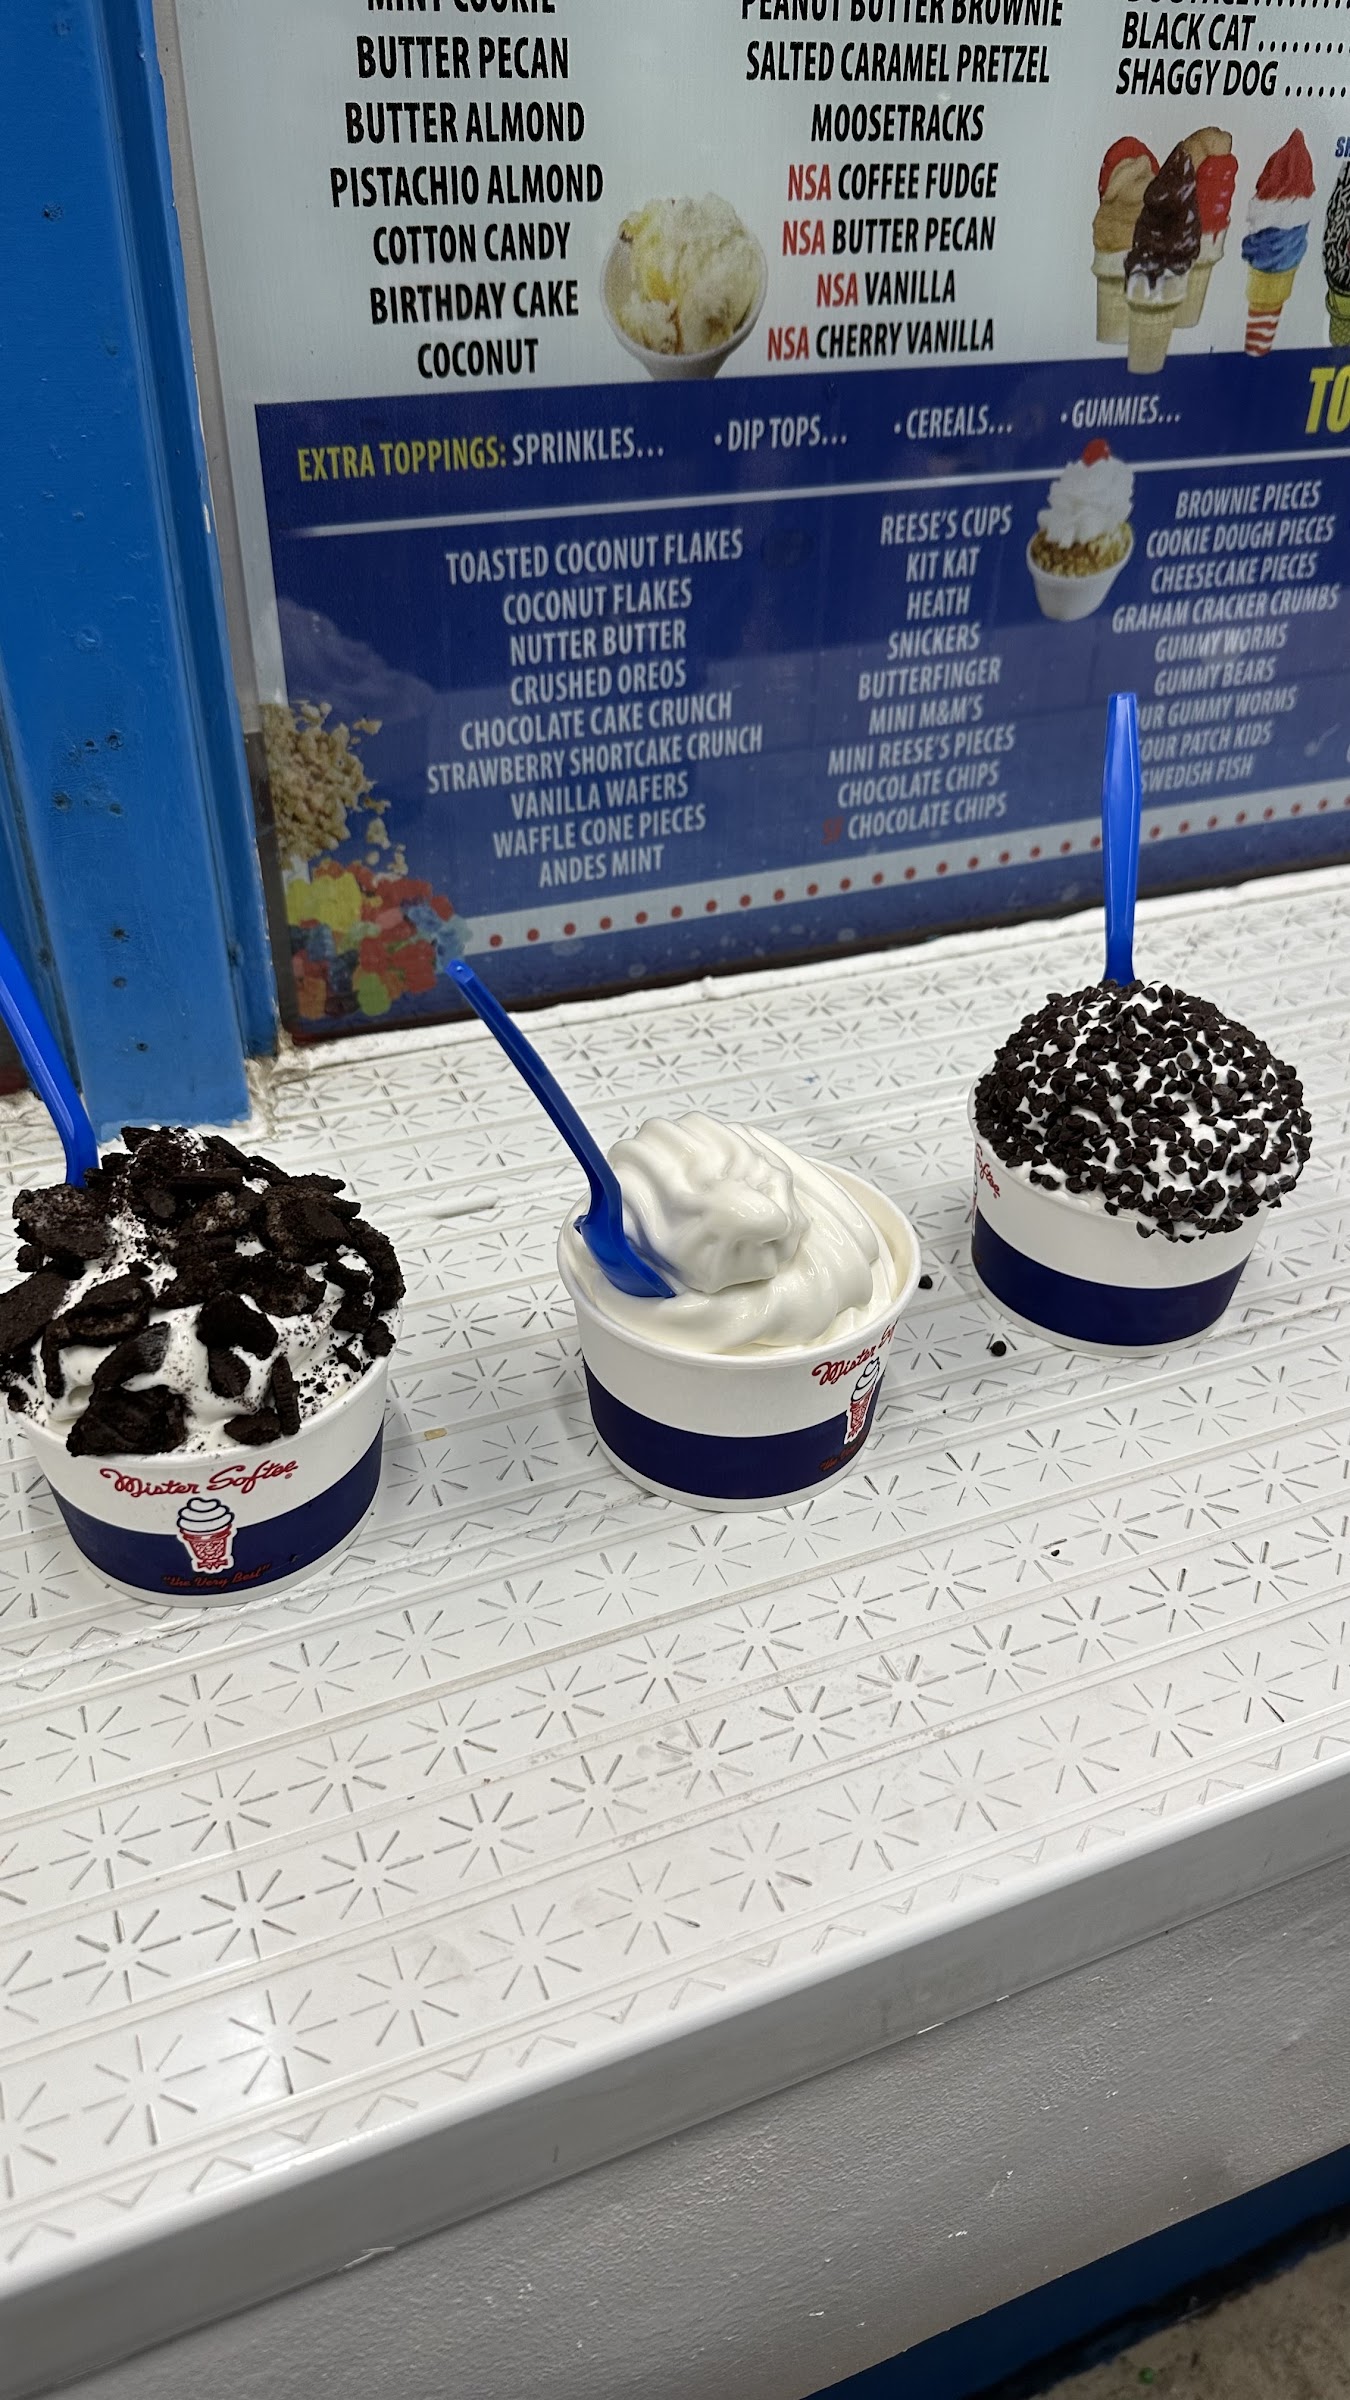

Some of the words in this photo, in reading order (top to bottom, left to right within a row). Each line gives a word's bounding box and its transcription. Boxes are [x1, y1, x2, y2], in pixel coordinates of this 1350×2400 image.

[1122, 11, 1205, 50] BLACK
[356, 36, 470, 78] BUTTER
[479, 37, 569, 78] PECAN
[746, 41, 834, 81] SALTED
[841, 43, 949, 82] CARAMEL
[957, 45, 1049, 83] PRETZEL
[1115, 57, 1221, 95] SHAGGY
[345, 102, 458, 144] BUTTER
[466, 102, 585, 142] ALMOND
[811, 104, 985, 142] MOOSETRACKS
[330, 165, 479, 207] PISTACHIO
[487, 164, 603, 203] ALMOND
[788, 164, 832, 201] NSA
[838, 163, 920, 201] COFFEE
[925, 162, 998, 199] FUDGE
[373, 225, 476, 265] COTTON
[484, 222, 570, 260] CANDY
[782, 220, 826, 256] NSA
[832, 218, 920, 255] BUTTER
[925, 216, 996, 253] PECAN
[370, 283, 508, 324] BIRTHDAY
[514, 280, 579, 317] CAKE
[816, 273, 859, 308] NSA
[864, 270, 956, 305] VANILLA
[417, 338, 538, 378] COCONUT
[767, 326, 809, 361] NSA
[816, 322, 903, 359] CHERRY
[905, 319, 994, 354] VANILLA
[298, 445, 375, 482] EXTRA
[380, 435, 507, 475] TOPPINGS:
[1175, 484, 1261, 520] BROWNIE
[1265, 480, 1323, 510] PIECES
[881, 510, 959, 546] REESE'S
[962, 504, 1013, 538] CUPS
[1146, 525, 1210, 559] COOKIE
[1214, 520, 1277, 553] DOUGH
[1280, 515, 1335, 546] PIECES
[446, 545, 550, 584] TOASTED
[555, 536, 659, 576] COCONUT
[664, 529, 744, 564] FLAKES
[906, 550, 940, 583] KIT
[942, 547, 981, 579] KAT
[1151, 558, 1257, 594] CHEESECAKE
[1260, 552, 1318, 582] PIECES
[503, 586, 607, 625] COCONUT
[612, 578, 692, 613] FLAKES
[907, 586, 972, 621] HEATH
[1112, 599, 1188, 634] GRAHAM
[1192, 592, 1266, 625] CRACKER
[1270, 583, 1340, 615] CRUMBS
[510, 628, 597, 666] NUTTER
[603, 618, 686, 656] BUTTER
[887, 622, 981, 661] SNICKERS
[1155, 631, 1222, 663] GUMMY
[1223, 623, 1289, 656] WORMS
[511, 667, 612, 706] CRUSHED
[617, 659, 686, 694] OREOS
[858, 656, 1001, 701] BUTTERFINGER
[1154, 665, 1221, 697] GUMMY
[1222, 657, 1277, 688] BEARS
[461, 709, 585, 751] CHOCOLATE
[590, 703, 643, 736] CAKE
[649, 691, 732, 729] CRUNCH
[869, 704, 914, 736] MINI
[919, 695, 984, 729] M&M'S
[1137, 704, 1164, 732] UR
[1167, 695, 1233, 728] GUMMY
[1234, 685, 1298, 718] WORMS
[428, 750, 566, 794] STRAWBERRY
[569, 738, 682, 777] SHORTCAKE
[687, 725, 763, 761] CRUNCH
[828, 745, 874, 776] MINI
[878, 733, 950, 769] REESE'S
[954, 724, 1016, 759] PIECES
[1140, 734, 1177, 763] OUR
[1180, 724, 1232, 758] PATCH
[1233, 719, 1275, 749] KIDS
[838, 767, 942, 809] CHOCOLATE
[945, 759, 1000, 793] CHIPS
[1141, 761, 1213, 794] SWEDISH
[1216, 753, 1256, 782] FISH
[511, 784, 600, 820] VANILLA
[606, 771, 689, 807] WAFERS
[848, 799, 952, 841] CHOCOLATE
[954, 792, 1007, 826] CHIPS
[493, 823, 576, 859] WAFFLE
[581, 814, 634, 847] CONE
[640, 804, 706, 839] PIECES
[539, 851, 607, 888] ANDES
[612, 844, 664, 877] MINT
[812, 1345, 877, 1386] Mister
[100, 1468, 199, 1498] Mister
[206, 1460, 299, 1495] Softee
